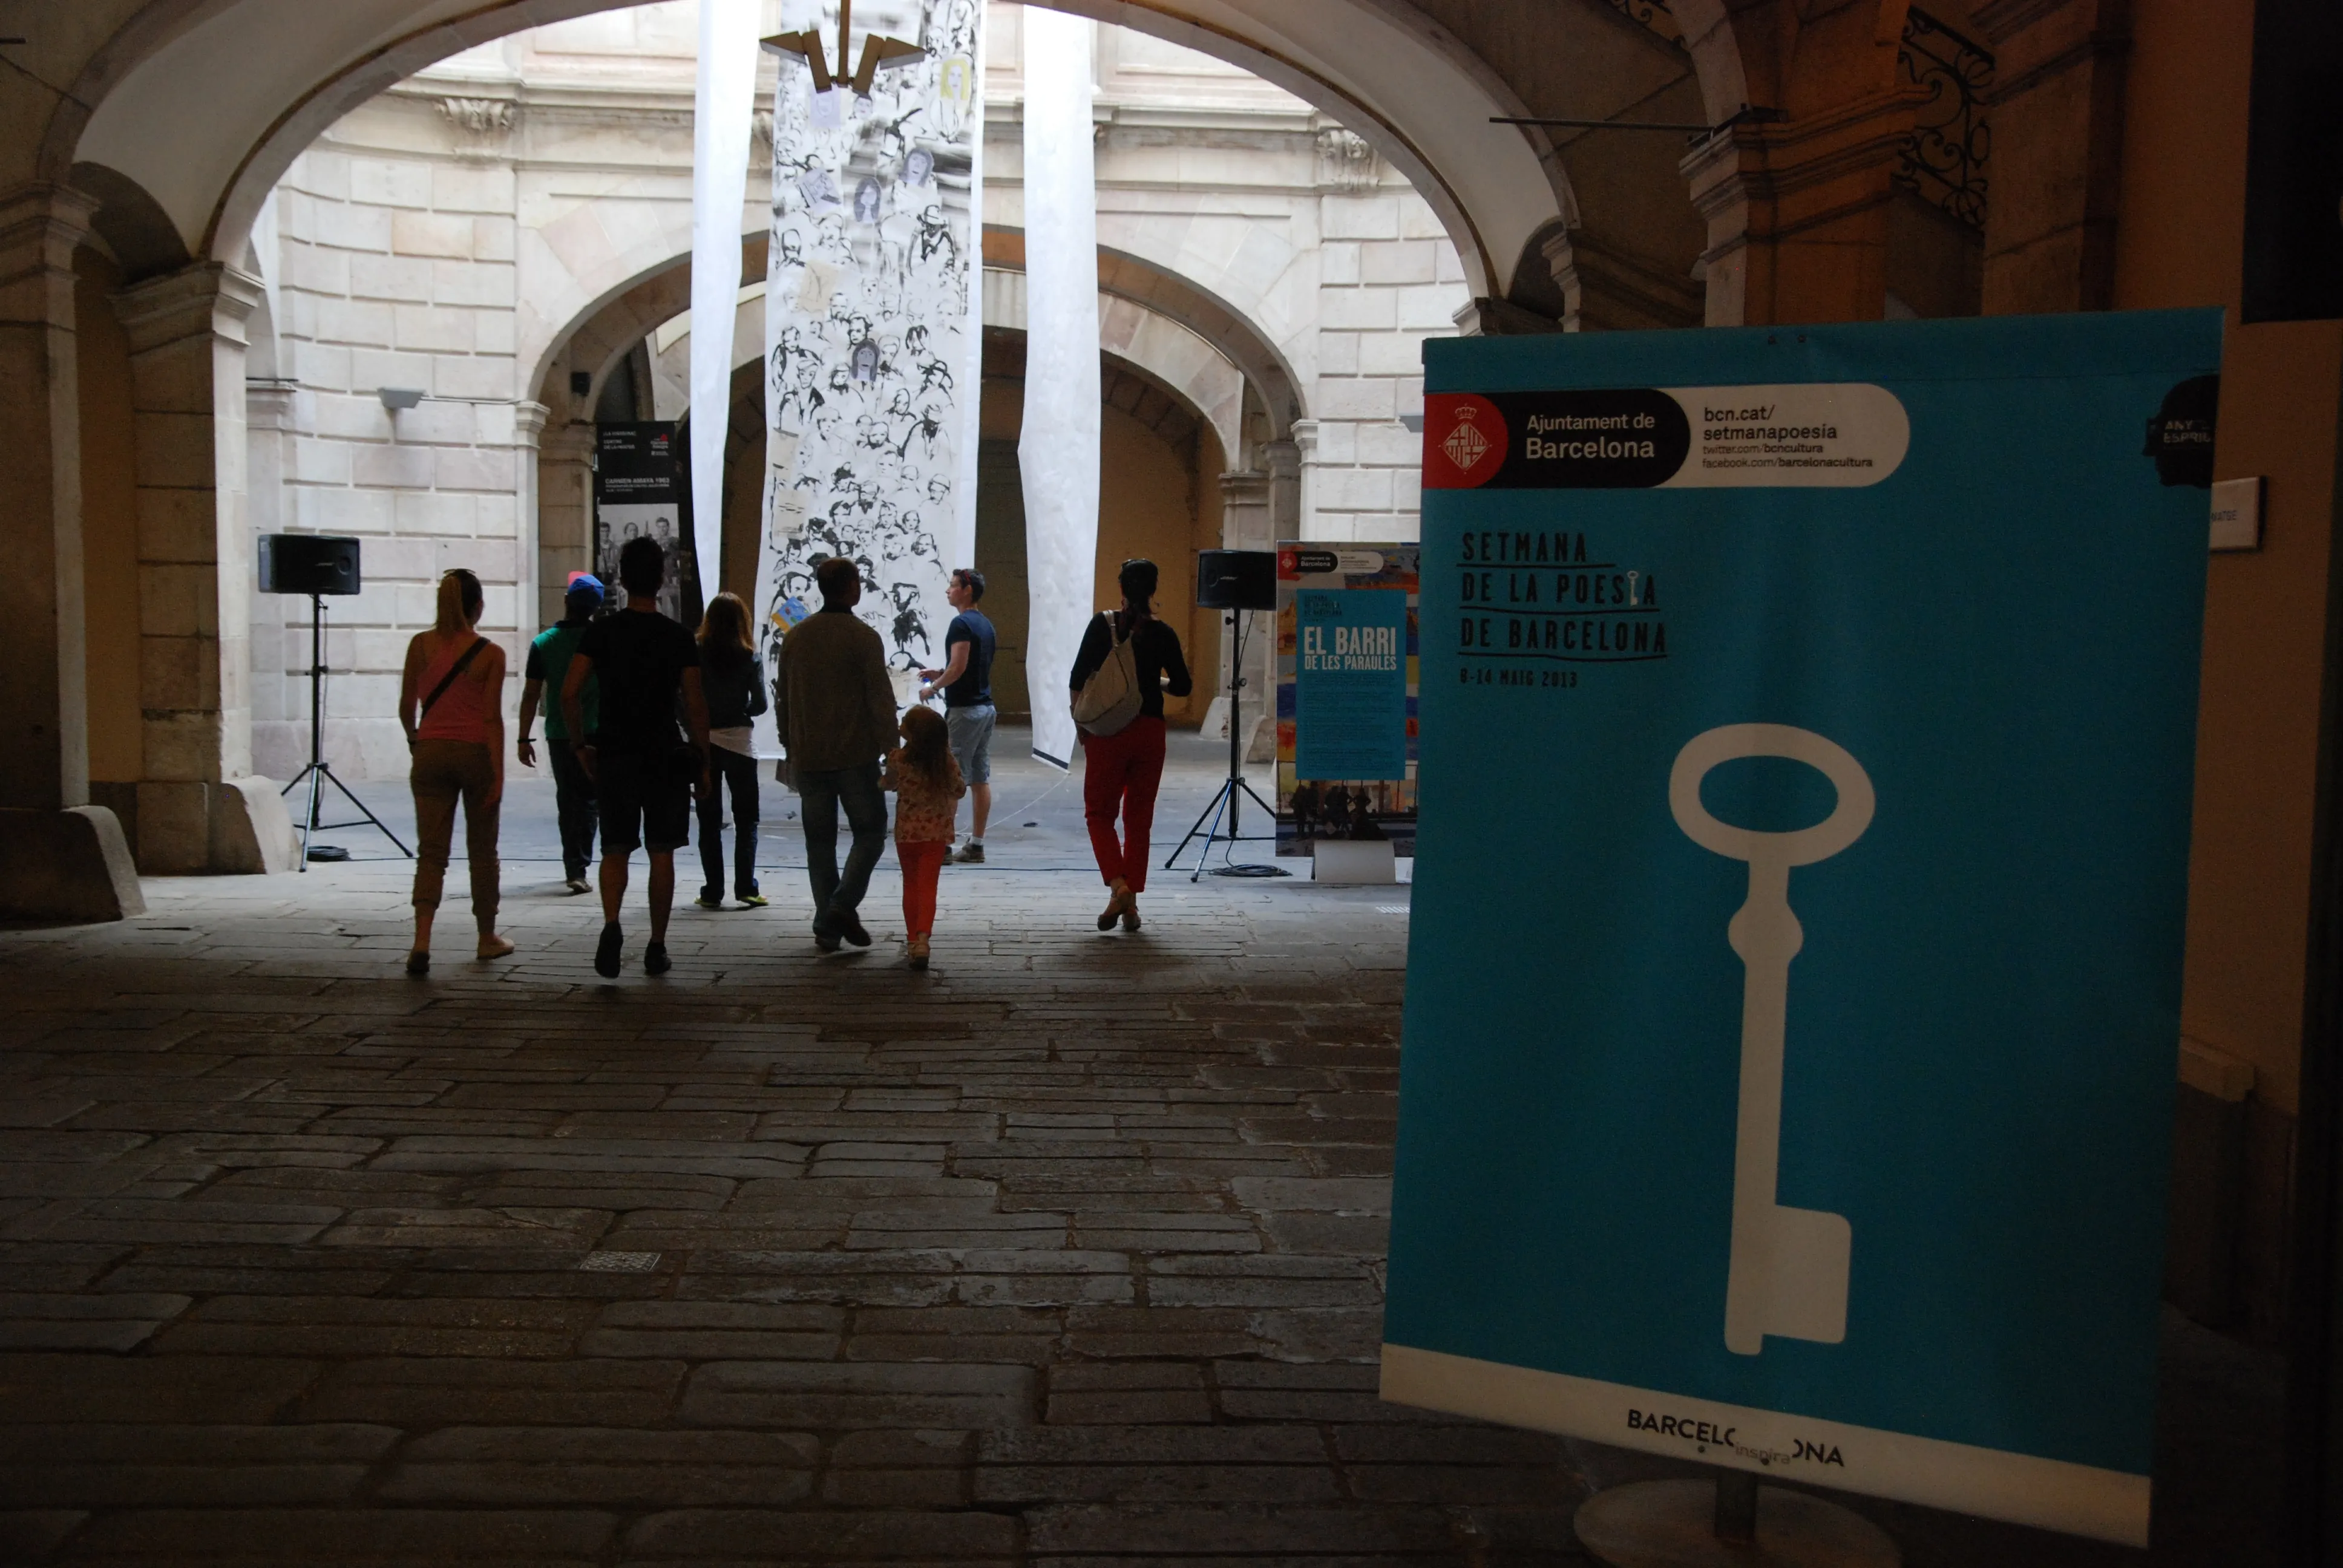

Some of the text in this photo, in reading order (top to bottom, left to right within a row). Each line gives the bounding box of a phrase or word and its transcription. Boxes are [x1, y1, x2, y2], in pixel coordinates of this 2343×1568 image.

[1527, 412, 1655, 435] Ajuntament de
[1704, 405, 1775, 421] bcn.cat/
[1703, 423, 1837, 442] setmanapoesia
[1526, 436, 1655, 459] Barcelona
[1702, 443, 1823, 454] twitter.com/bcncultura
[1702, 457, 1873, 468] facebook.com/barcelonacultura
[1462, 532, 1587, 561] SETMANA
[1461, 572, 1492, 602] DE
[1510, 573, 1537, 603] LA
[1304, 626, 1396, 655] EL BARRI
[1461, 618, 1665, 653] DE BARCELONA
[1305, 655, 1397, 670] DE LES PARAULES
[1499, 669, 1533, 687] MAIG
[1542, 670, 1578, 688] 2013
[1735, 1442, 1791, 1465] inspira
